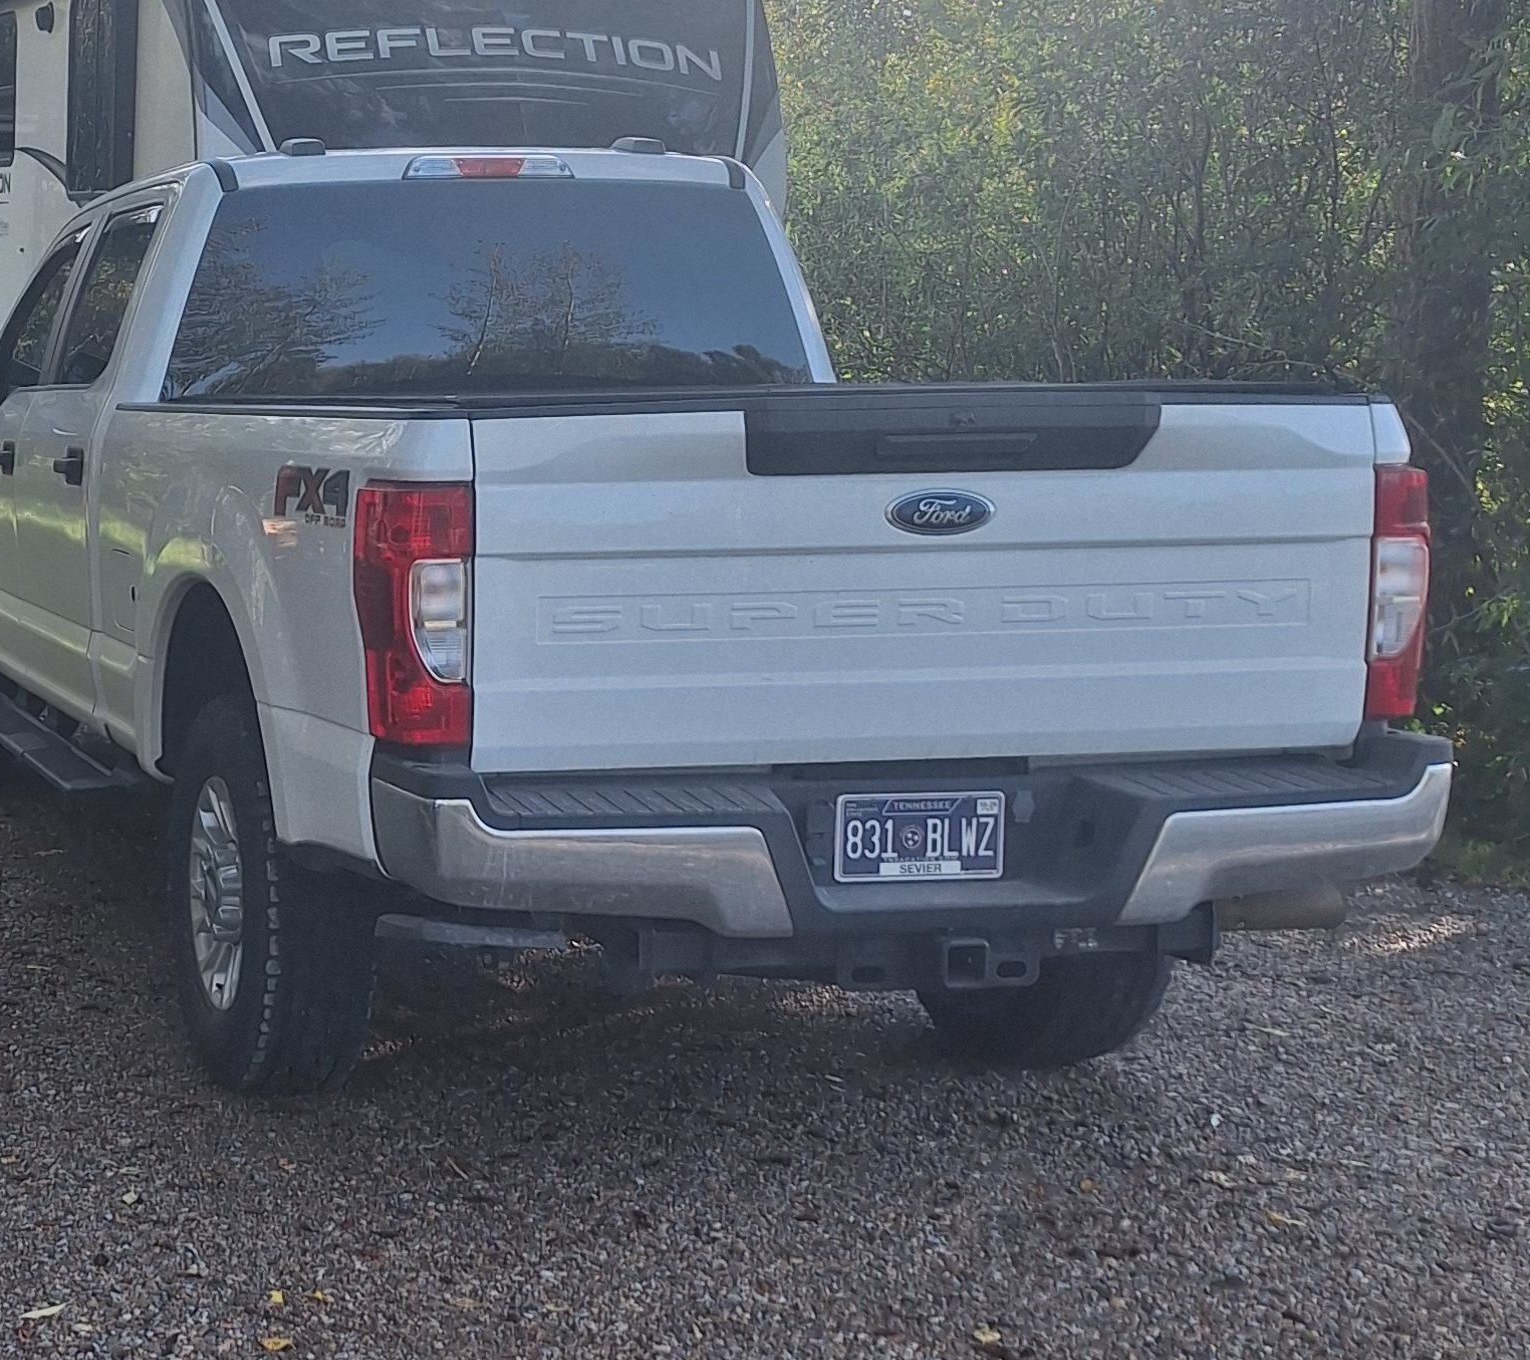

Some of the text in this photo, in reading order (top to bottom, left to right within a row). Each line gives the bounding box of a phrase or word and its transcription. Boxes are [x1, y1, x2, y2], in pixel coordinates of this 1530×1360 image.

[267, 25, 723, 82] REFLECTION
[273, 465, 350, 517] FX4
[913, 498, 972, 524] Ford
[551, 588, 1298, 634] SUPER DUTY
[893, 800, 952, 811] TENNESSEE
[846, 817, 995, 859] 831 BLWZ
[899, 863, 942, 874] SEVIER
